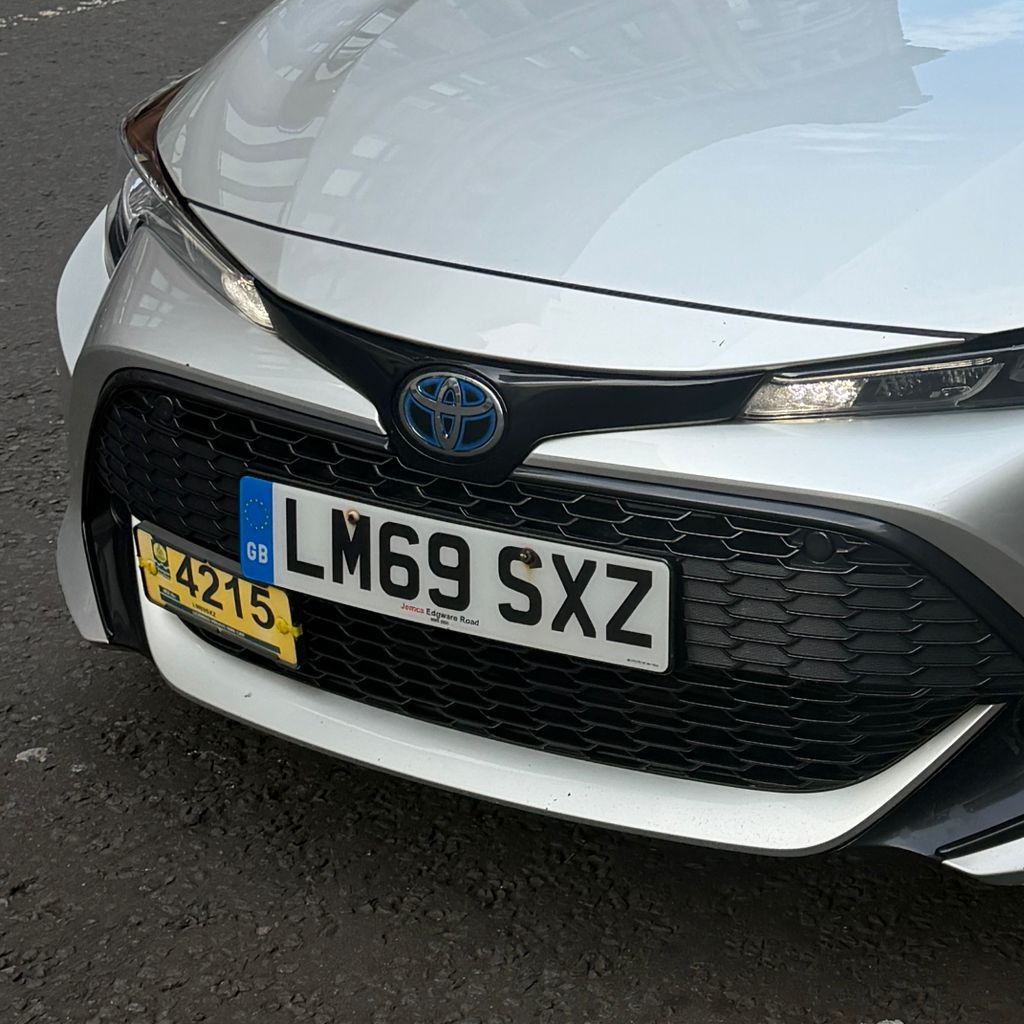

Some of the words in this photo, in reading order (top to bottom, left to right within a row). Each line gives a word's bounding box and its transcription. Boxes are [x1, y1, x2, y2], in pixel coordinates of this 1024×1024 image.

[175, 554, 276, 630] 4215
[246, 541, 269, 564] GB
[285, 497, 471, 612] LM69
[498, 545, 654, 650] SXZ
[426, 608, 458, 622] Edgware
[459, 615, 480, 627] Road
